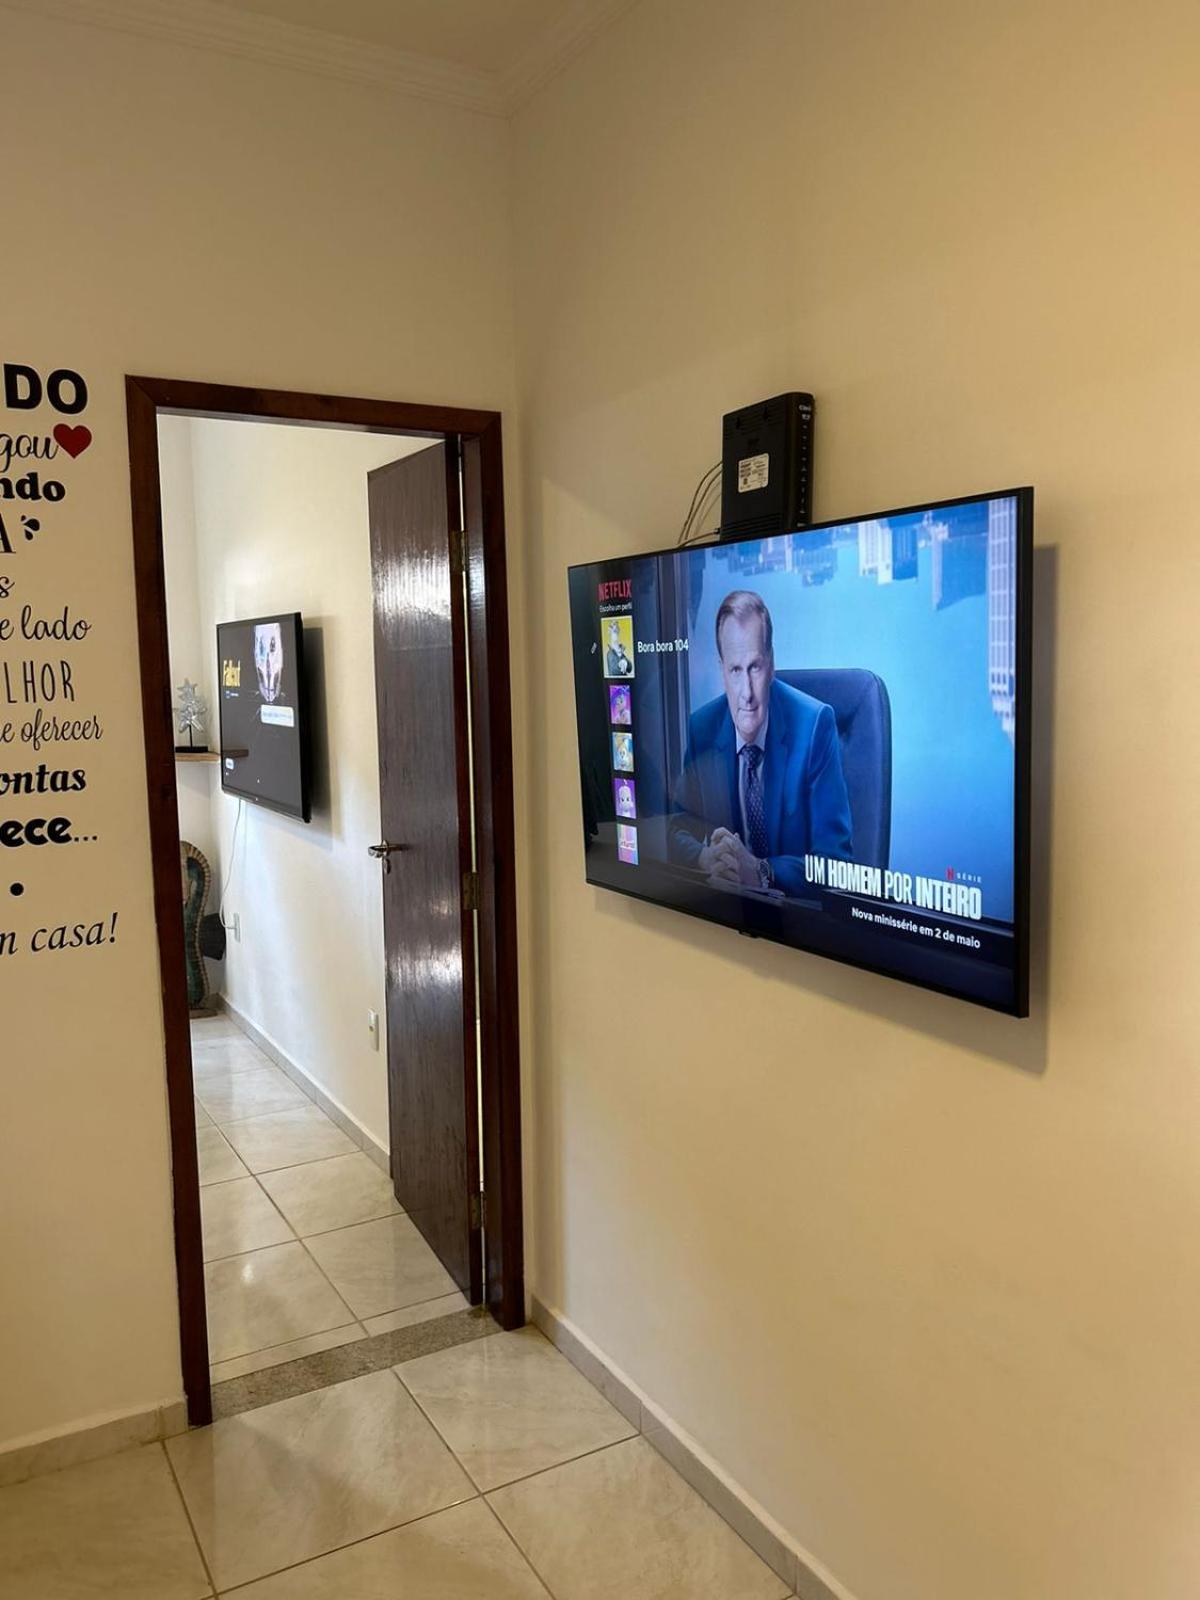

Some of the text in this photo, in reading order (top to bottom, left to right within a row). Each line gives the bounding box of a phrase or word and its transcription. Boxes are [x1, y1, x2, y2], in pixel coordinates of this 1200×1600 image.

[4, 363, 88, 415] DO
[598, 579, 633, 602] NETFLIX
[21, 605, 92, 641] lado
[637, 639, 689, 653] Bora bora 104
[4, 660, 75, 703] LHOR
[20, 708, 103, 752] oferecer
[804, 854, 982, 921] UM HOMEM POR INTEIRO
[31, 912, 118, 953] casa!
[852, 907, 981, 949] Nova minissérie em 2 de maio
